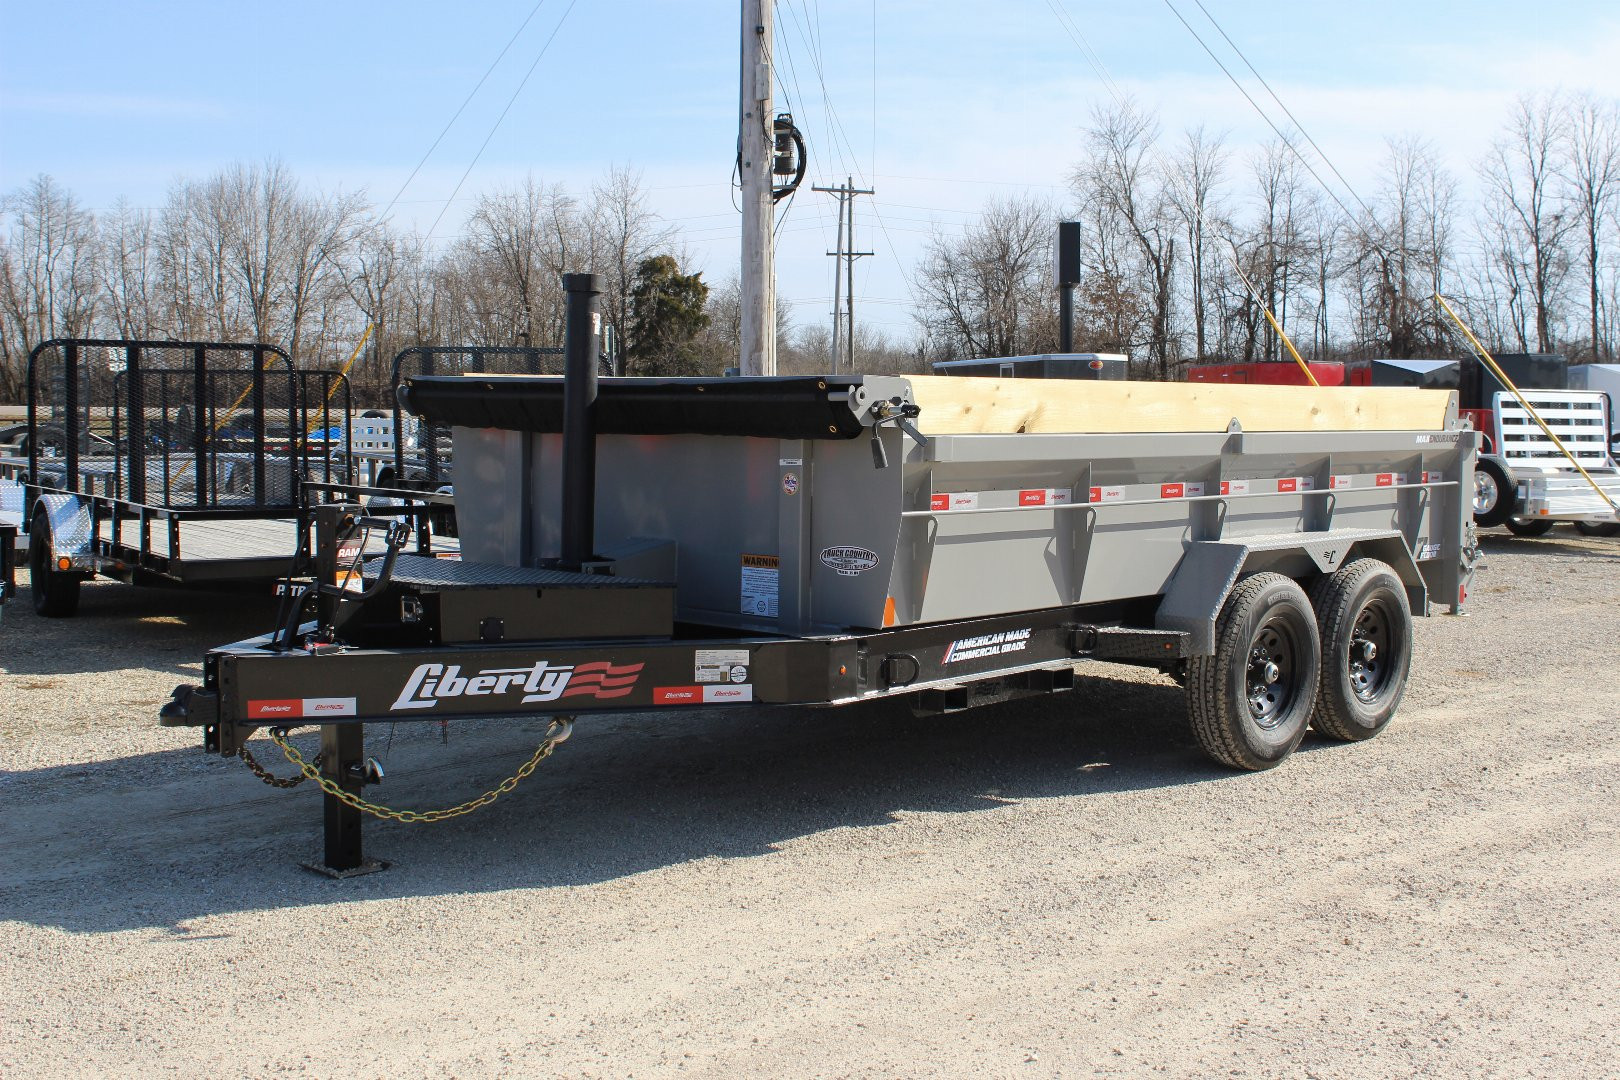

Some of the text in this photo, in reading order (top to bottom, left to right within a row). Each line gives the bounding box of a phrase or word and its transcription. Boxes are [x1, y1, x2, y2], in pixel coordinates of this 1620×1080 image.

[338, 547, 361, 558] RAM
[823, 549, 873, 561] TRUCK COUNTRY
[744, 555, 780, 568] WARNIN
[956, 628, 1031, 650] AMERICAN MADE
[951, 641, 1026, 662] COMMERCIAL GRADE
[390, 661, 575, 711] Liberty
